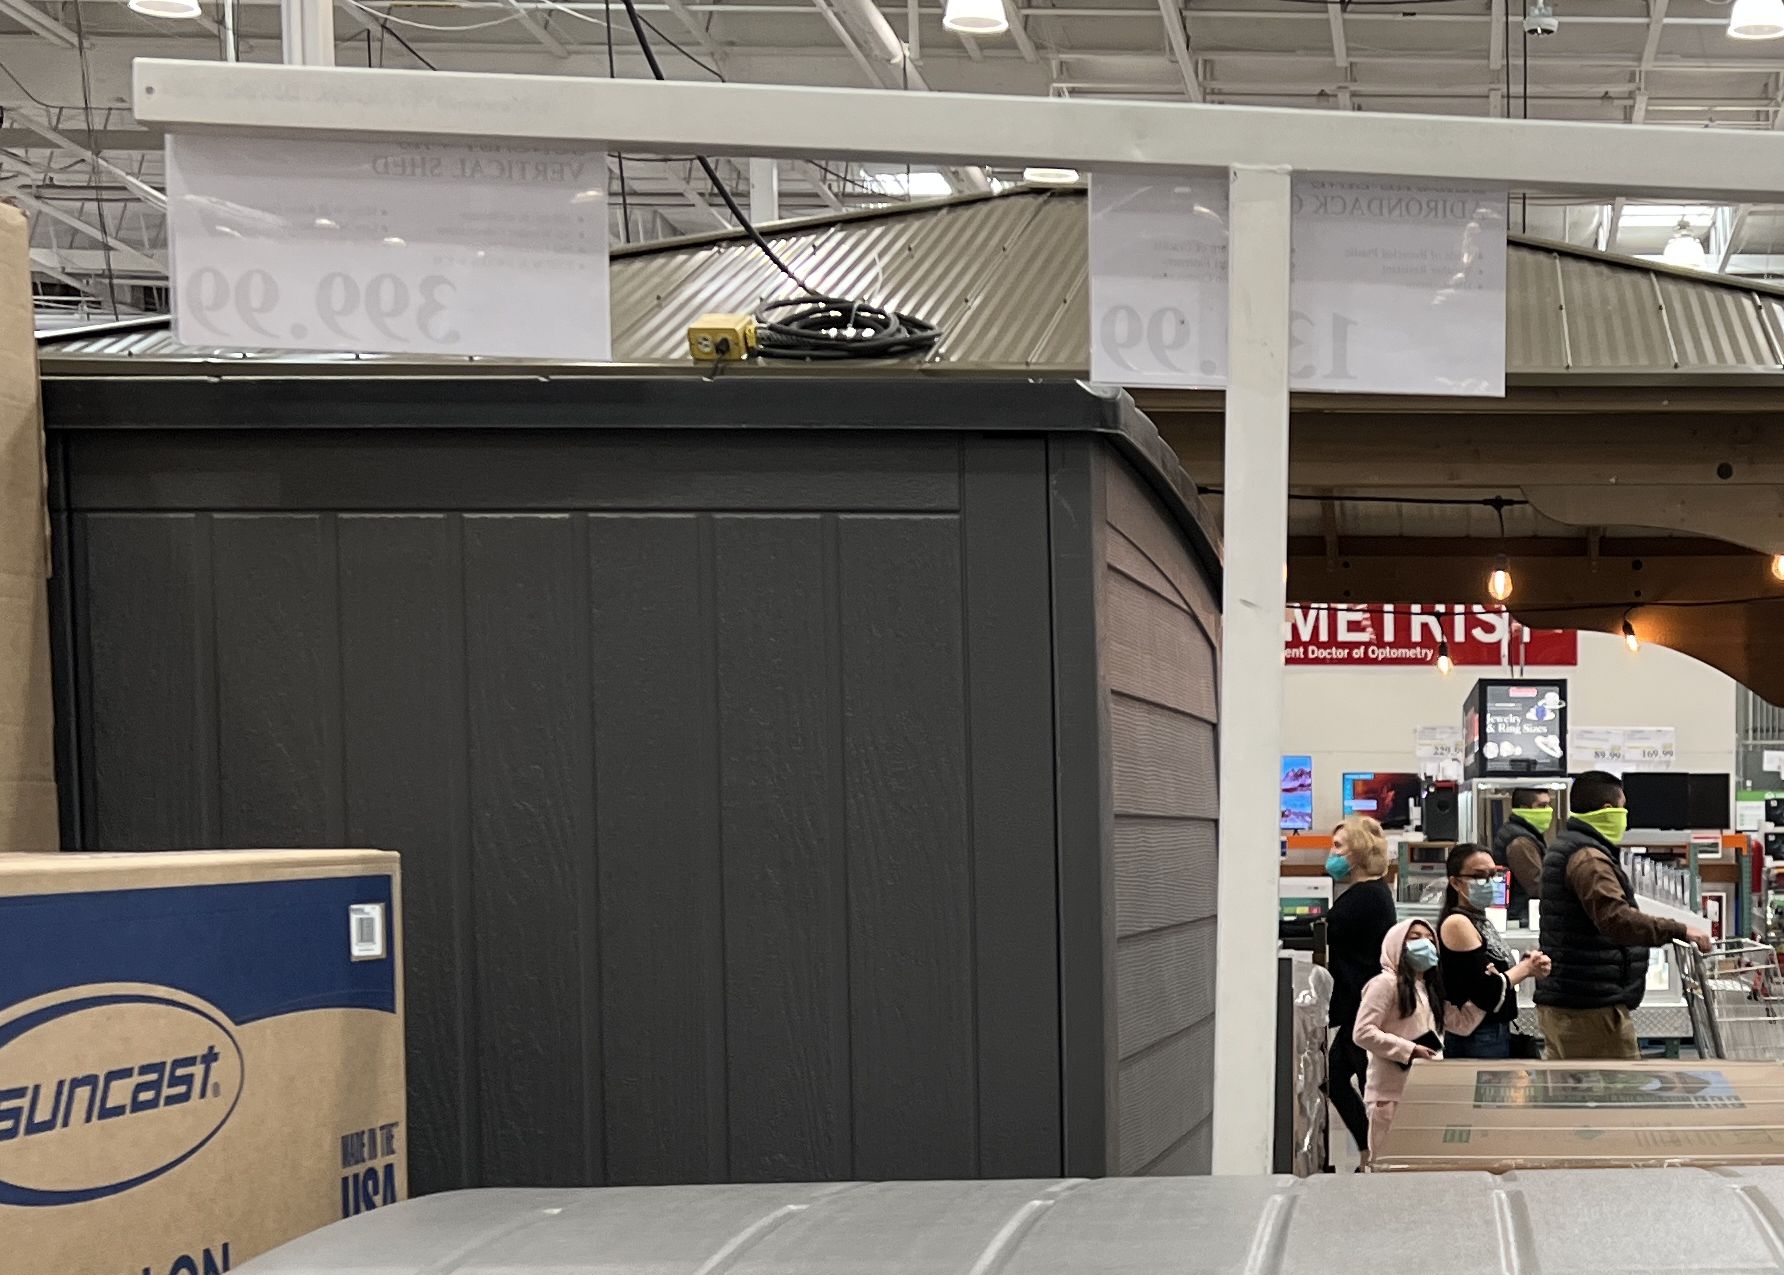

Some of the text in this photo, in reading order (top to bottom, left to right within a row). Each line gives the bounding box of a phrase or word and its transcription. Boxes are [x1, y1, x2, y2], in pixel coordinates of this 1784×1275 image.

[1308, 644, 1350, 660] Doctor
[1353, 644, 1365, 659] of
[1368, 645, 1434, 662] Optometry
[1486, 712, 1523, 726] Jewelry
[1486, 722, 1548, 736] & Ring Sizes
[1594, 750, 1622, 761] 89.99
[1642, 748, 1675, 760] 169.99
[0, 1044, 221, 1142] suncast
[380, 1121, 400, 1157] THE
[341, 1162, 398, 1219] USA
